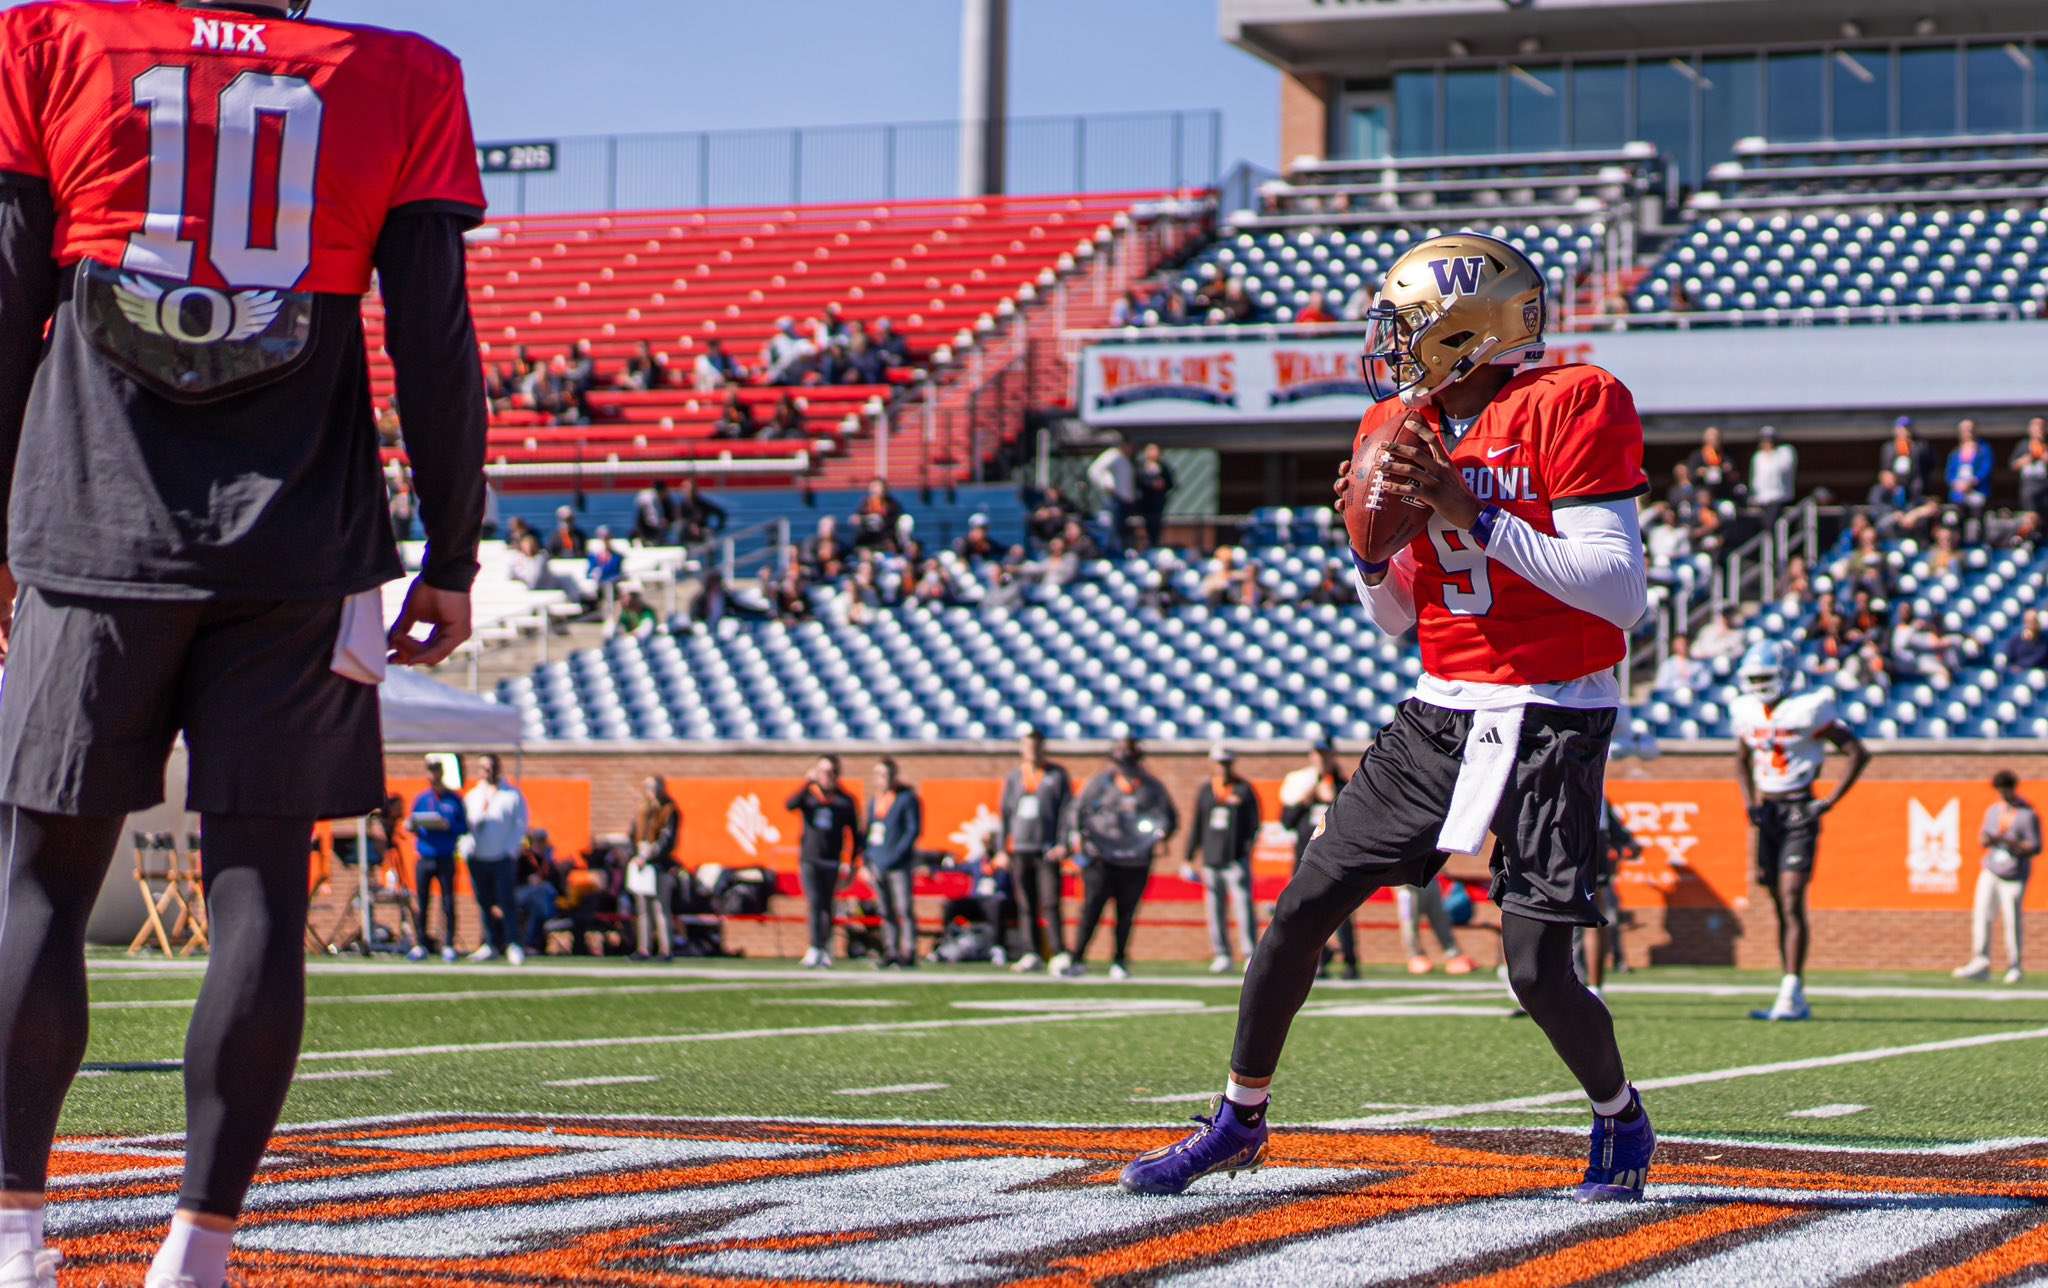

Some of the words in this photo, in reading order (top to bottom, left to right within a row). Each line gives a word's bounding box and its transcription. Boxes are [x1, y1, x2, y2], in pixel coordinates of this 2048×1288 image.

[191, 16, 268, 53] NIX
[121, 63, 324, 290] 10
[1428, 255, 1486, 298] W
[1462, 466, 1538, 501] BOWL
[1426, 509, 1494, 617] 9
[1612, 801, 1699, 833] RT
